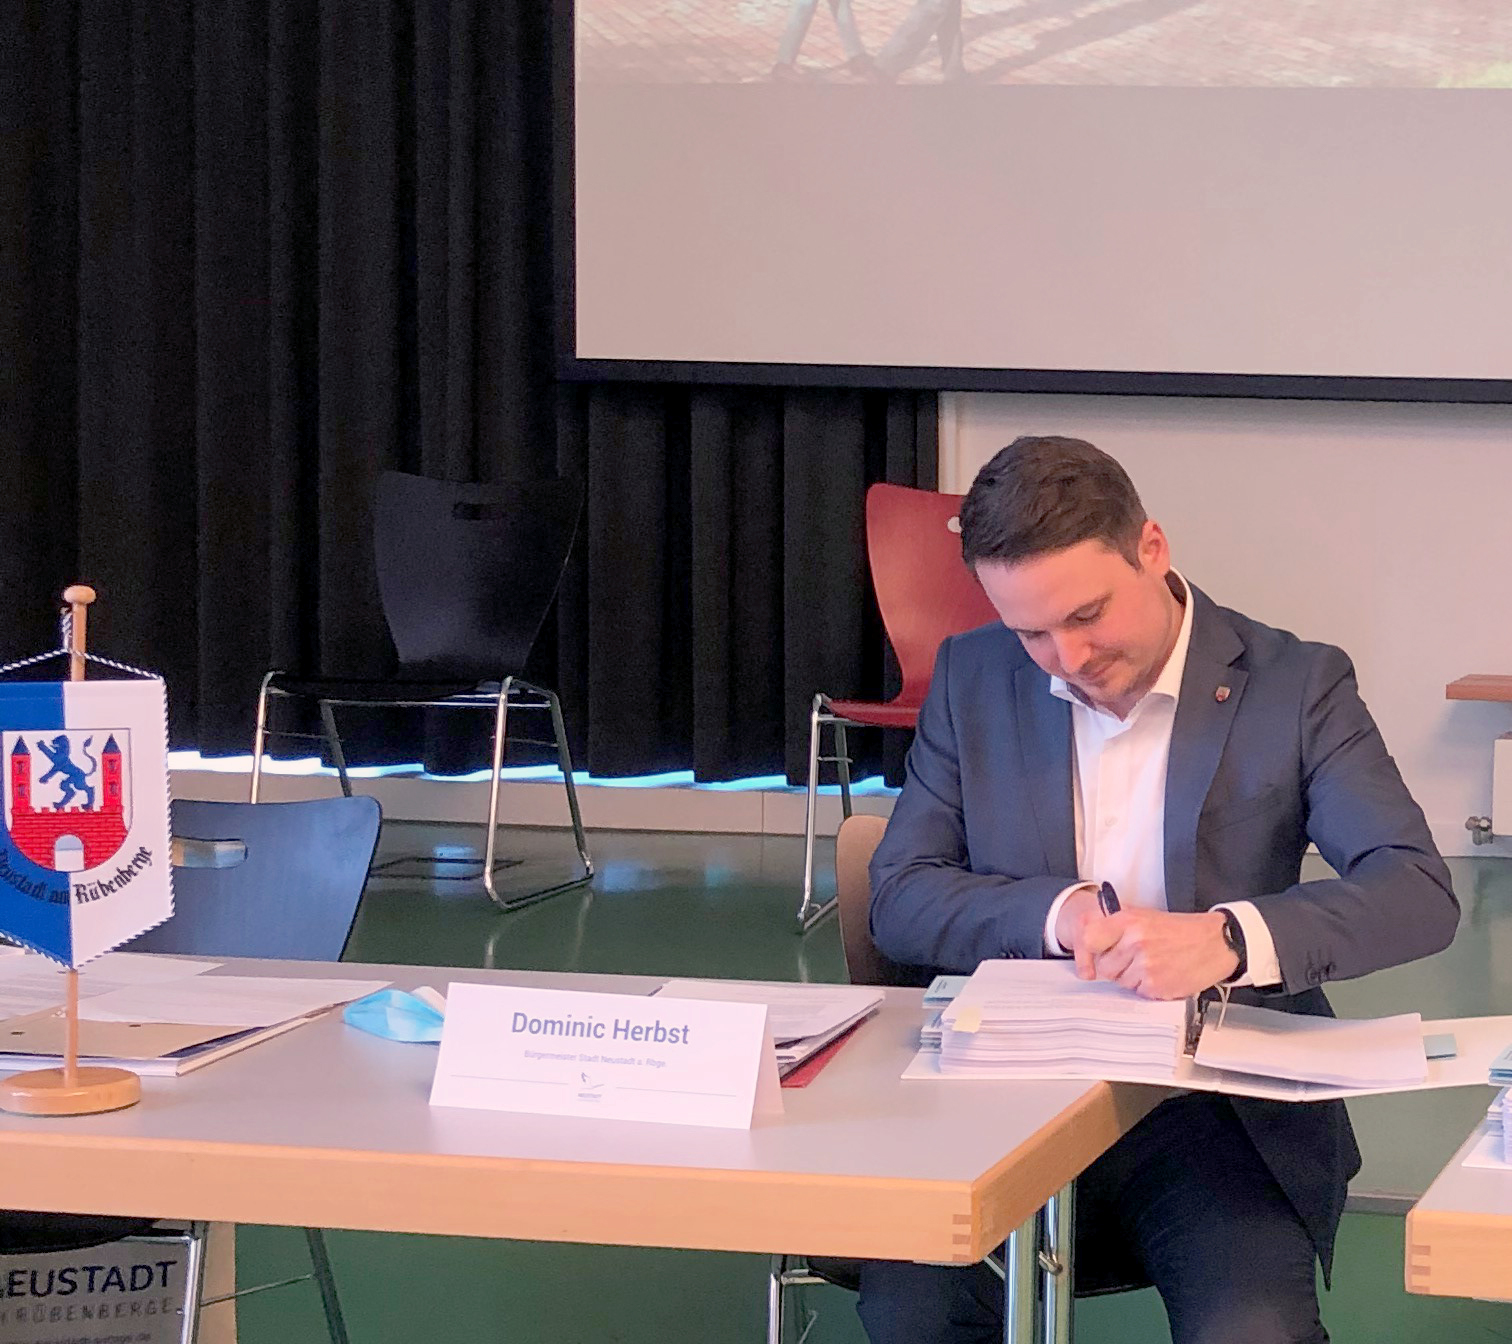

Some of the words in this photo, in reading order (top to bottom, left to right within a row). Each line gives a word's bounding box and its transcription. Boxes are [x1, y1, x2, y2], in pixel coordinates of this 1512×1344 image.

[511, 1011, 606, 1039] Dominic
[612, 1018, 691, 1045] Herbst
[0, 1260, 178, 1298] EUSTADT
